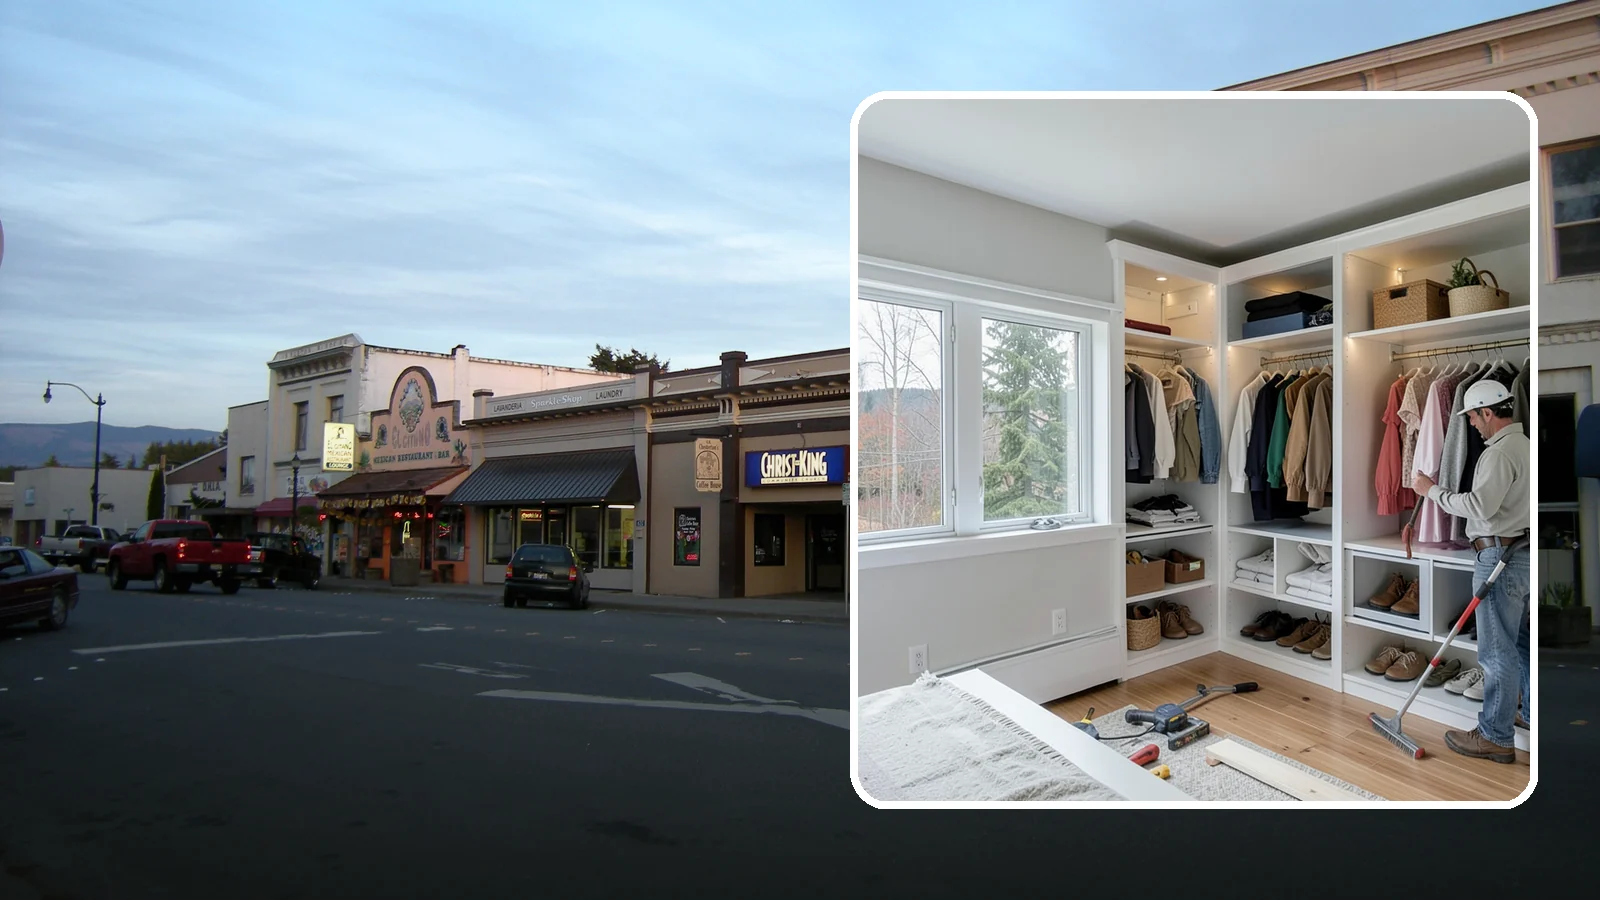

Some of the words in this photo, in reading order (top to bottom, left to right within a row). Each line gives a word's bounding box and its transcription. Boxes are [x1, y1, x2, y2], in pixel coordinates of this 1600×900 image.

[595, 388, 623, 400] LAUNDRY
[493, 402, 523, 413] LAVANDERIA
[530, 399, 562, 409] Sparkle
[562, 394, 583, 406] Shop
[374, 455, 396, 464] MEXICAN
[398, 452, 433, 462] RESTAURANT
[438, 450, 450, 459] BAR
[760, 452, 797, 478] CHRIST
[799, 449, 827, 477] KING
